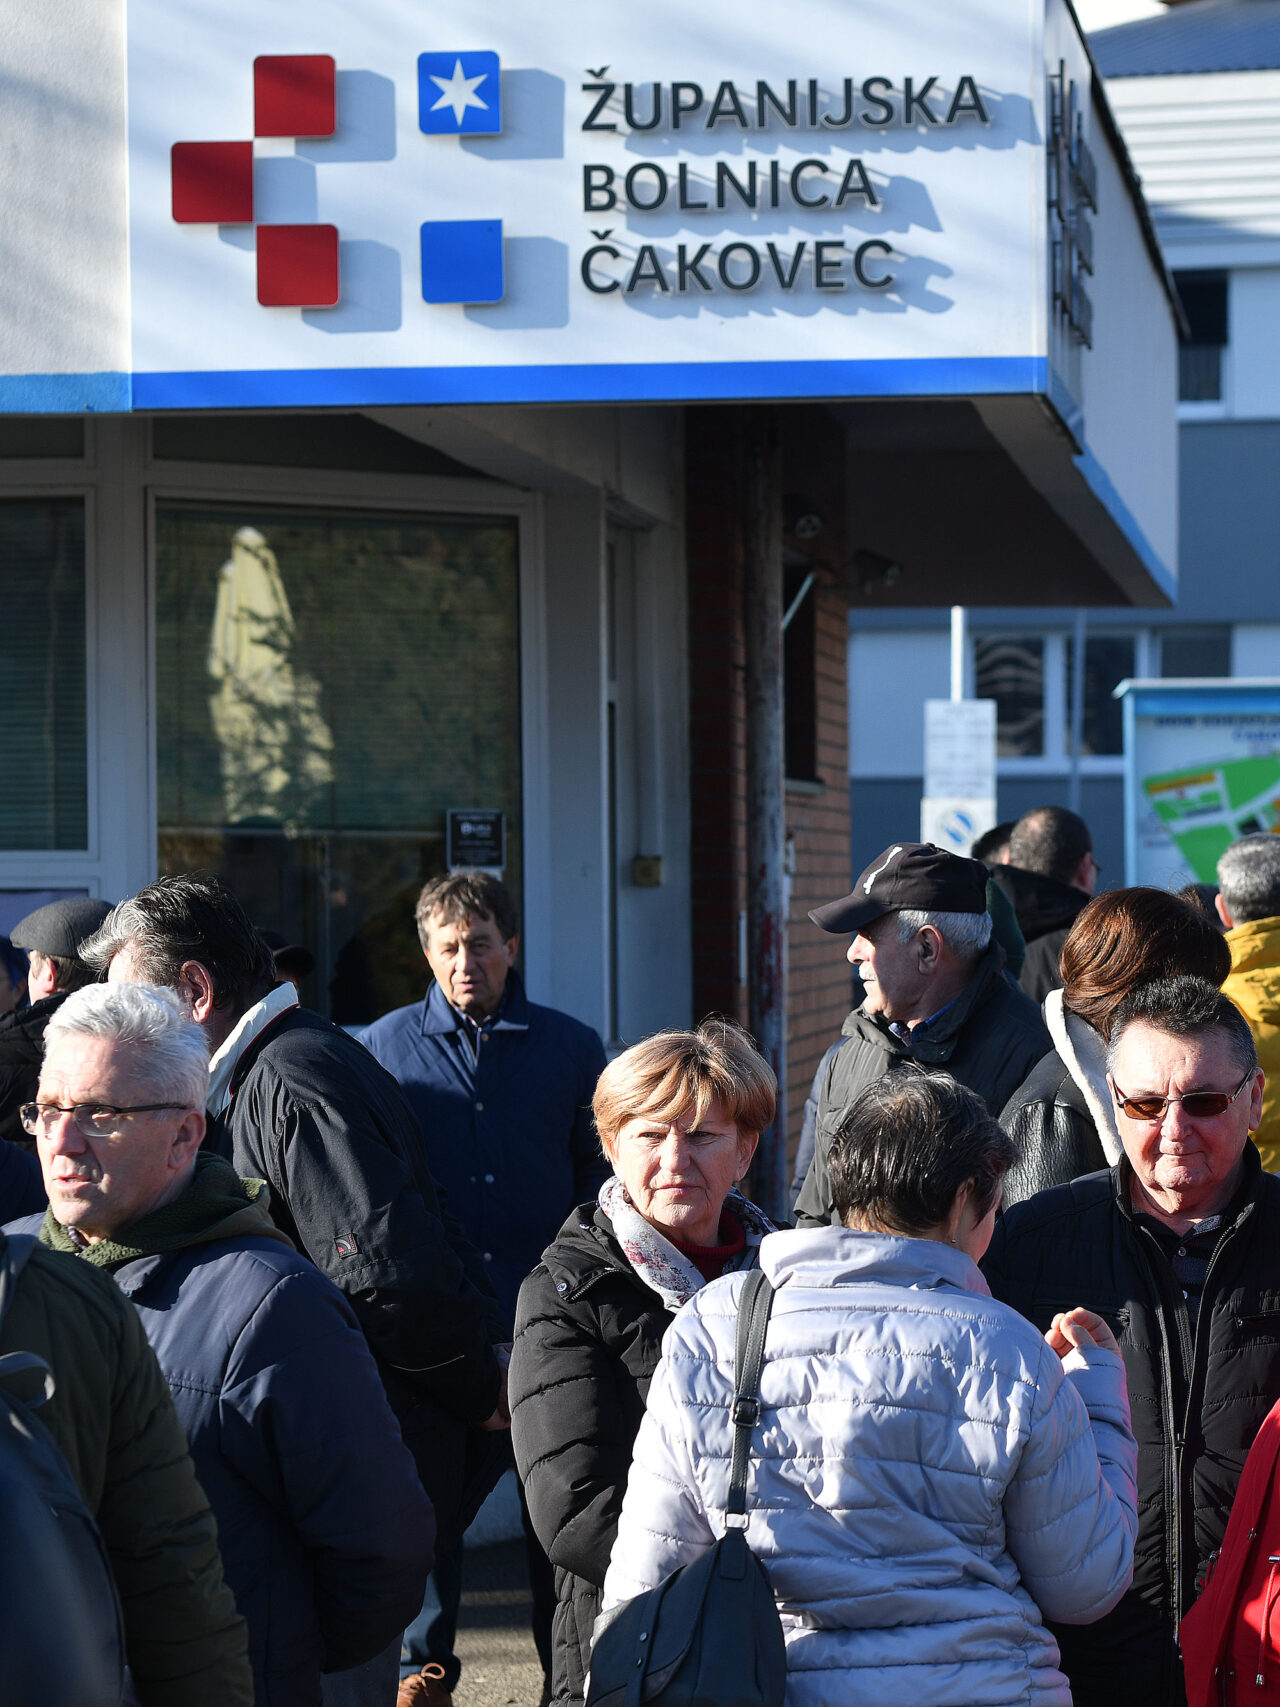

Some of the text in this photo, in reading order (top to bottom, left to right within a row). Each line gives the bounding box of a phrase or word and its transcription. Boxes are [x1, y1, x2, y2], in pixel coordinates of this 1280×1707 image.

[582, 66, 990, 132] ŽUPANIJSKA
[583, 158, 879, 212] BOLNICA
[581, 229, 894, 295] ČAKOVEC
